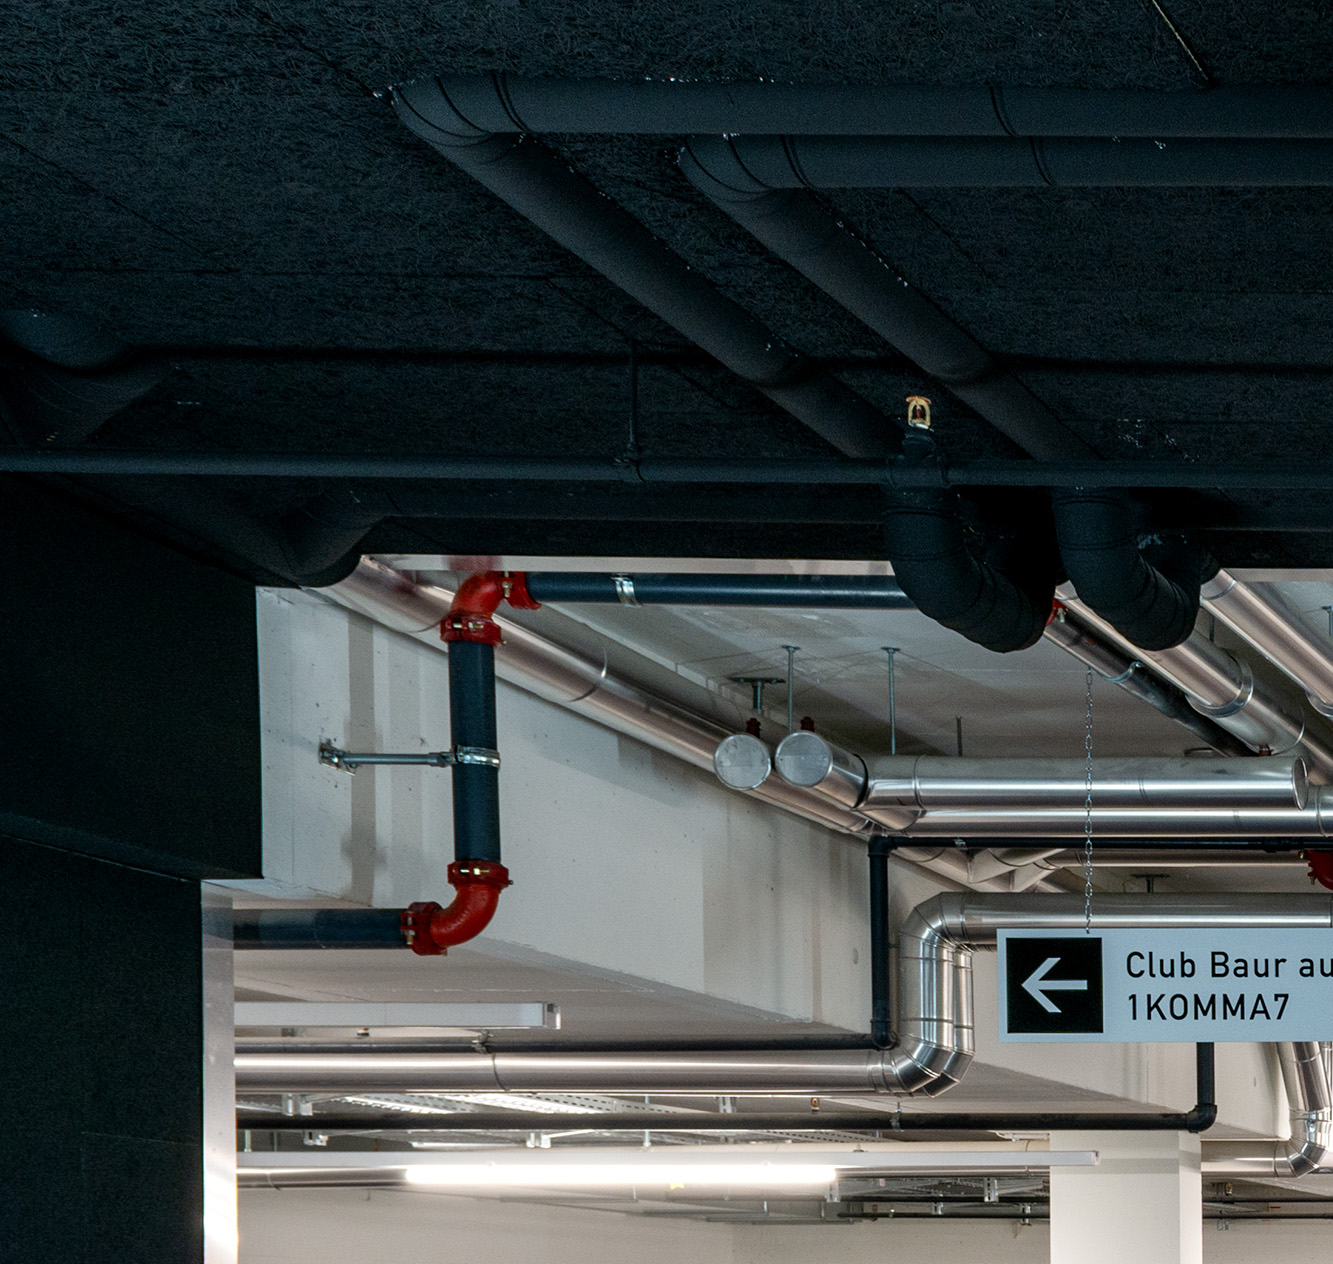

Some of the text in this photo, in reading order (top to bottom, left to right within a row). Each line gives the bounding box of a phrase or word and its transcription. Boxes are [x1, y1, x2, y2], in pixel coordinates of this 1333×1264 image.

[1127, 952, 1195, 978] Club
[1211, 952, 1287, 977] Baur
[1129, 994, 1288, 1020] 1KOMMA7
